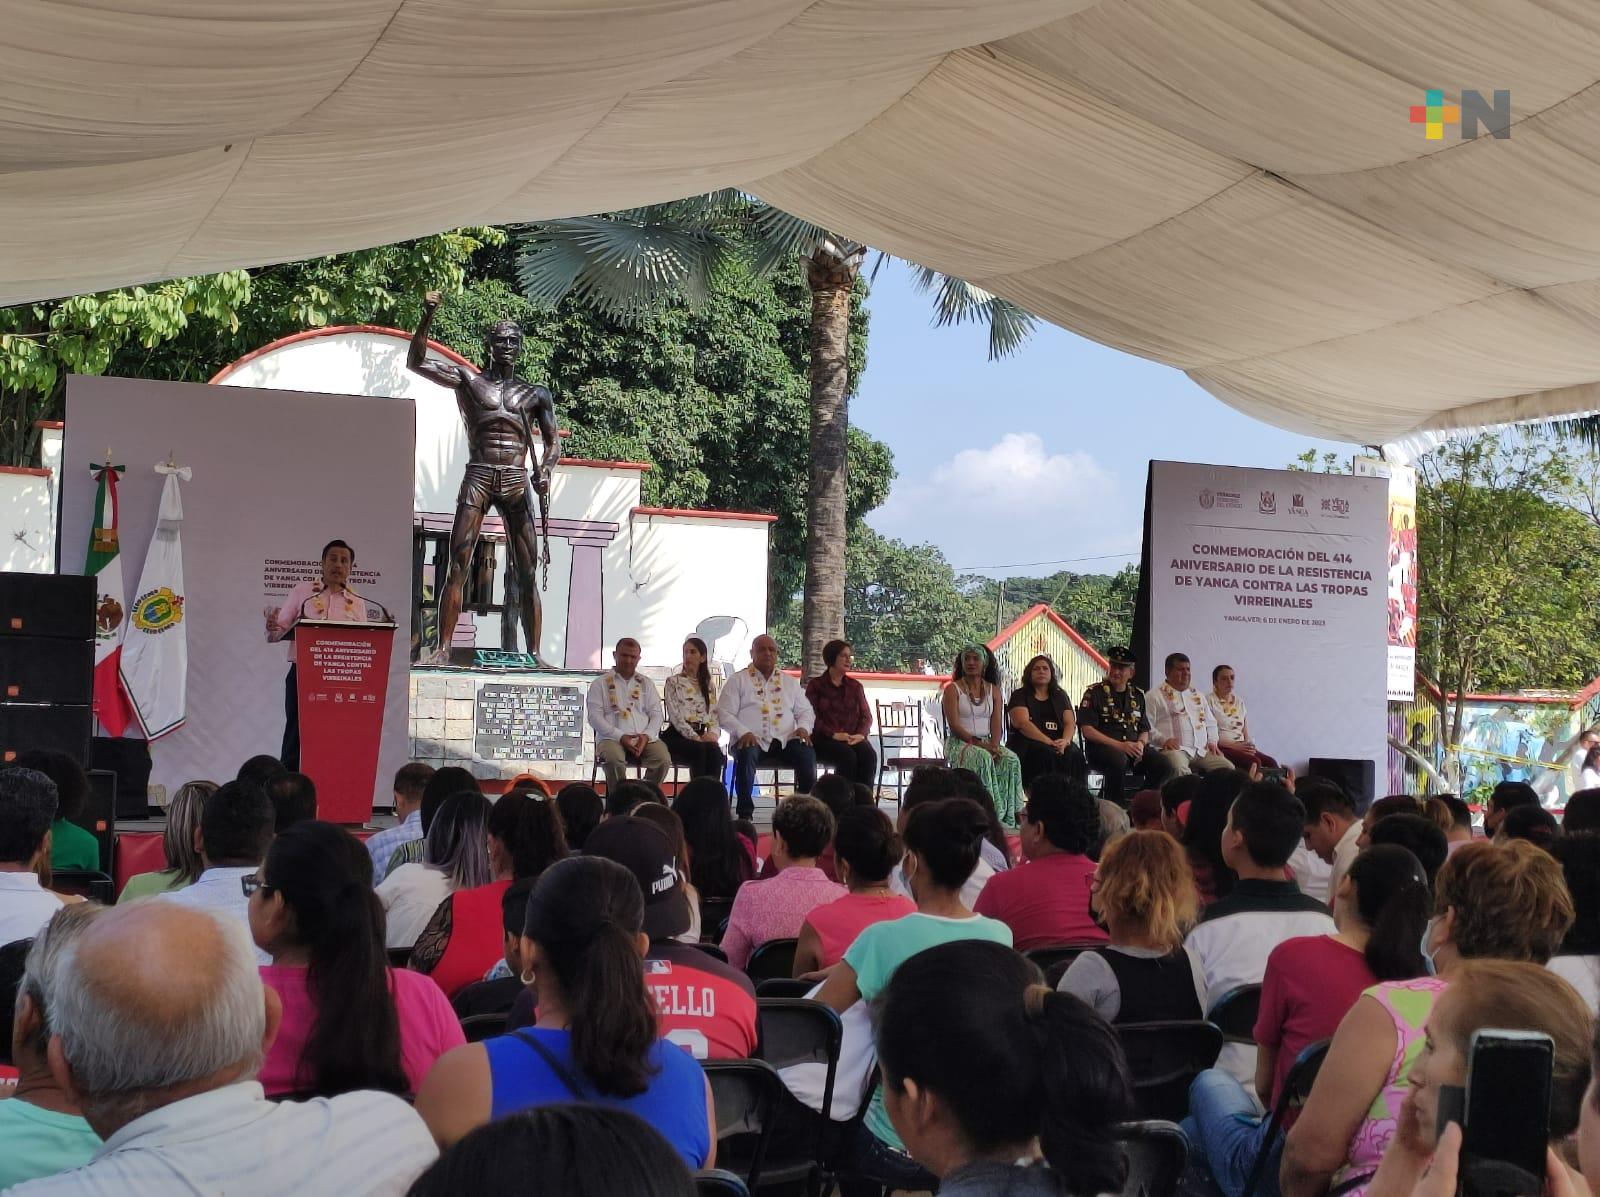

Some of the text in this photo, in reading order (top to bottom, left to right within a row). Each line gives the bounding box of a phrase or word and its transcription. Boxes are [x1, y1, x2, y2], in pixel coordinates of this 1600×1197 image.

[1192, 543, 1353, 564] CONMEMORACIÓN DEL 414
[1170, 559, 1372, 581] ANIVERSARIO DE LA RESISTENCIA
[1174, 575, 1369, 597] DE YANGA CONTRA LAS TROPAS
[1234, 594, 1313, 609] VIRREINALES
[1268, 616, 1277, 624] DE
[1278, 617, 1300, 625] ENERO
[332, 654, 372, 662] RESISTENCIA
[651, 874, 674, 894] PUMA
[647, 985, 715, 1018] ELLO
